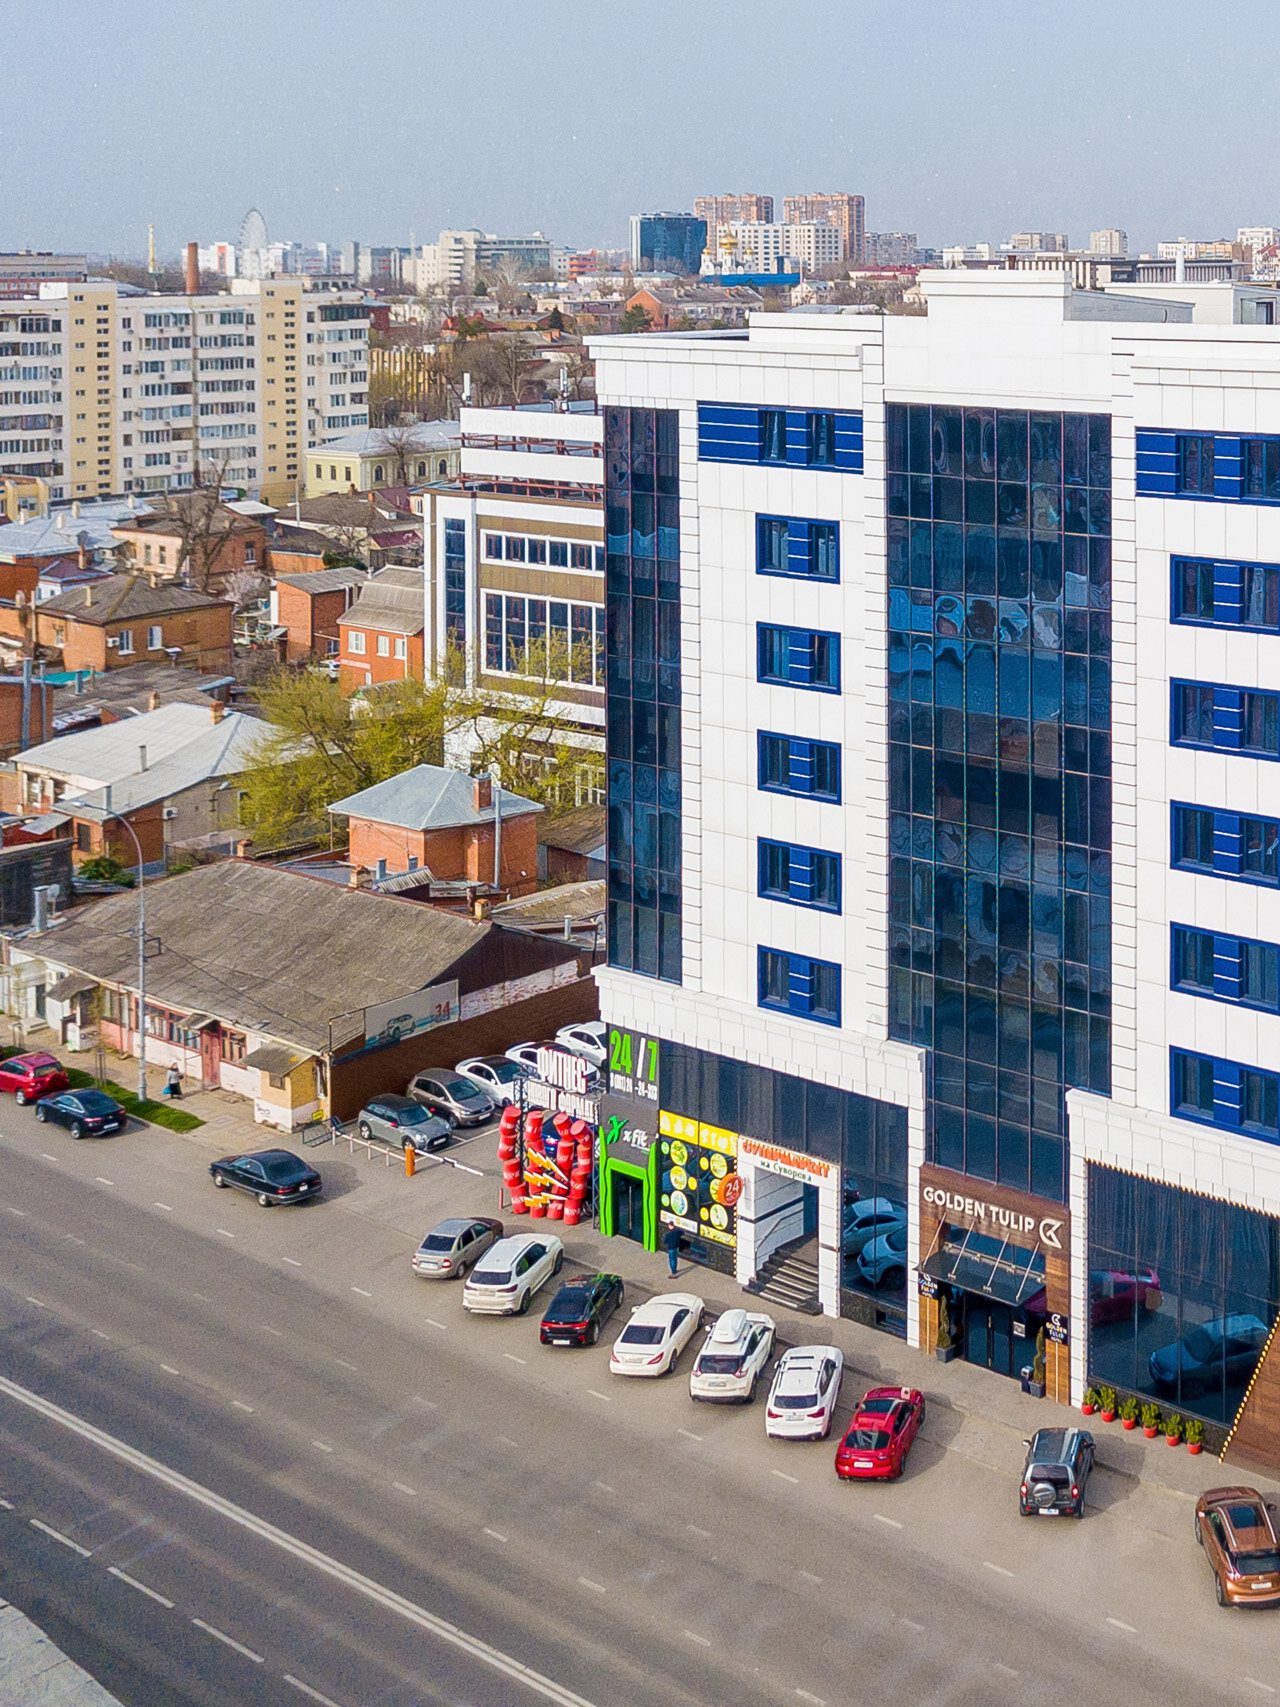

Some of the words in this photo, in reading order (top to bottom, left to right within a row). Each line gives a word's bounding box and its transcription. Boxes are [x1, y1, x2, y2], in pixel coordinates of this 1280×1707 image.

[537, 1047, 588, 1094] ФИТНЕС
[742, 1139, 831, 1179] СУПЕРМАРКЕТ
[760, 1160, 770, 1169] на
[726, 1179, 740, 1197] 24
[923, 1186, 986, 1219] GOLDEN
[989, 1204, 1035, 1233] TULIP
